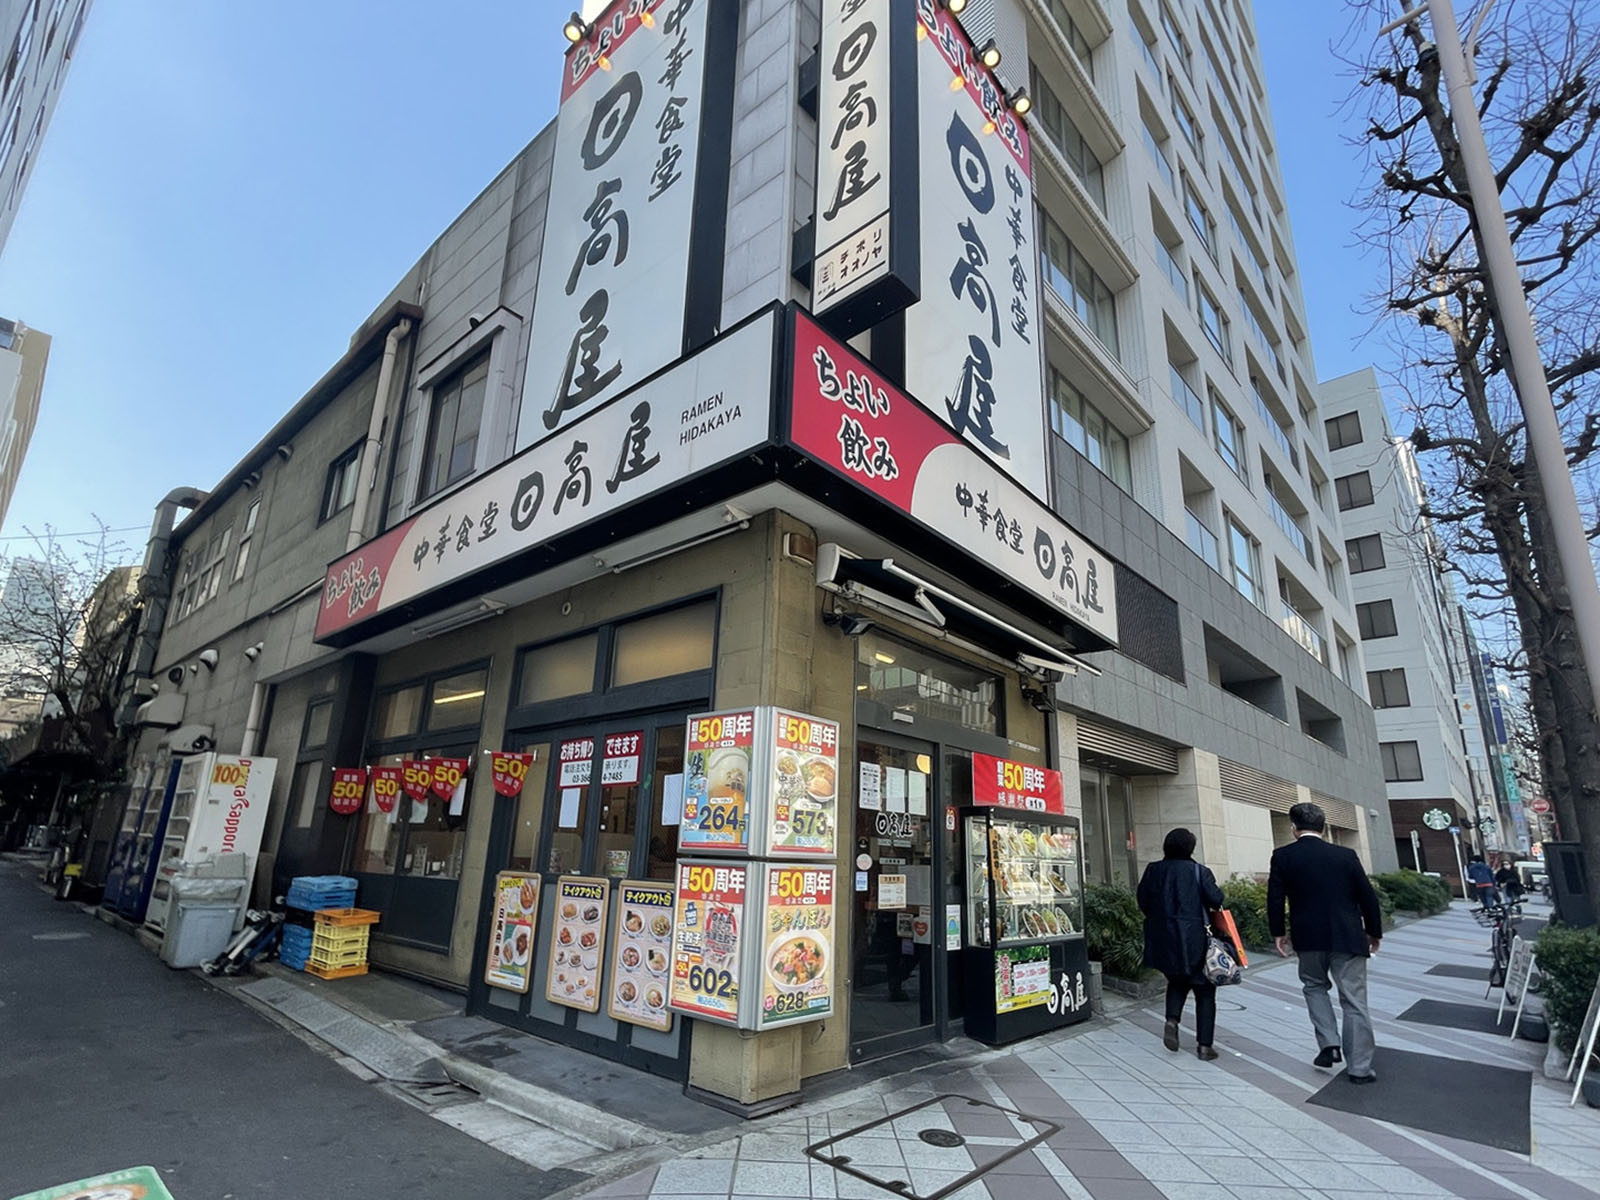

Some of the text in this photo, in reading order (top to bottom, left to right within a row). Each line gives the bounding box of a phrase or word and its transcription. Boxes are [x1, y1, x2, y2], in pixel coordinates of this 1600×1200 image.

[647, 0, 695, 202] 中華食堂
[823, 21, 881, 221] 日高屋
[542, 71, 643, 430] 日高屋
[945, 110, 1010, 461] 日高屋
[1004, 164, 1031, 344] 中華食堂
[679, 405, 742, 446] HIDAKAYA
[680, 391, 724, 425] RAMEN
[813, 345, 892, 418] ちょい
[413, 401, 661, 571] 中華食堂 日高屋
[836, 413, 899, 480] 飲み
[326, 557, 364, 609] ちょい
[347, 566, 382, 618] 飲み
[955, 482, 1104, 613] 中華食堂 日高屋
[606, 735, 639, 755] できます
